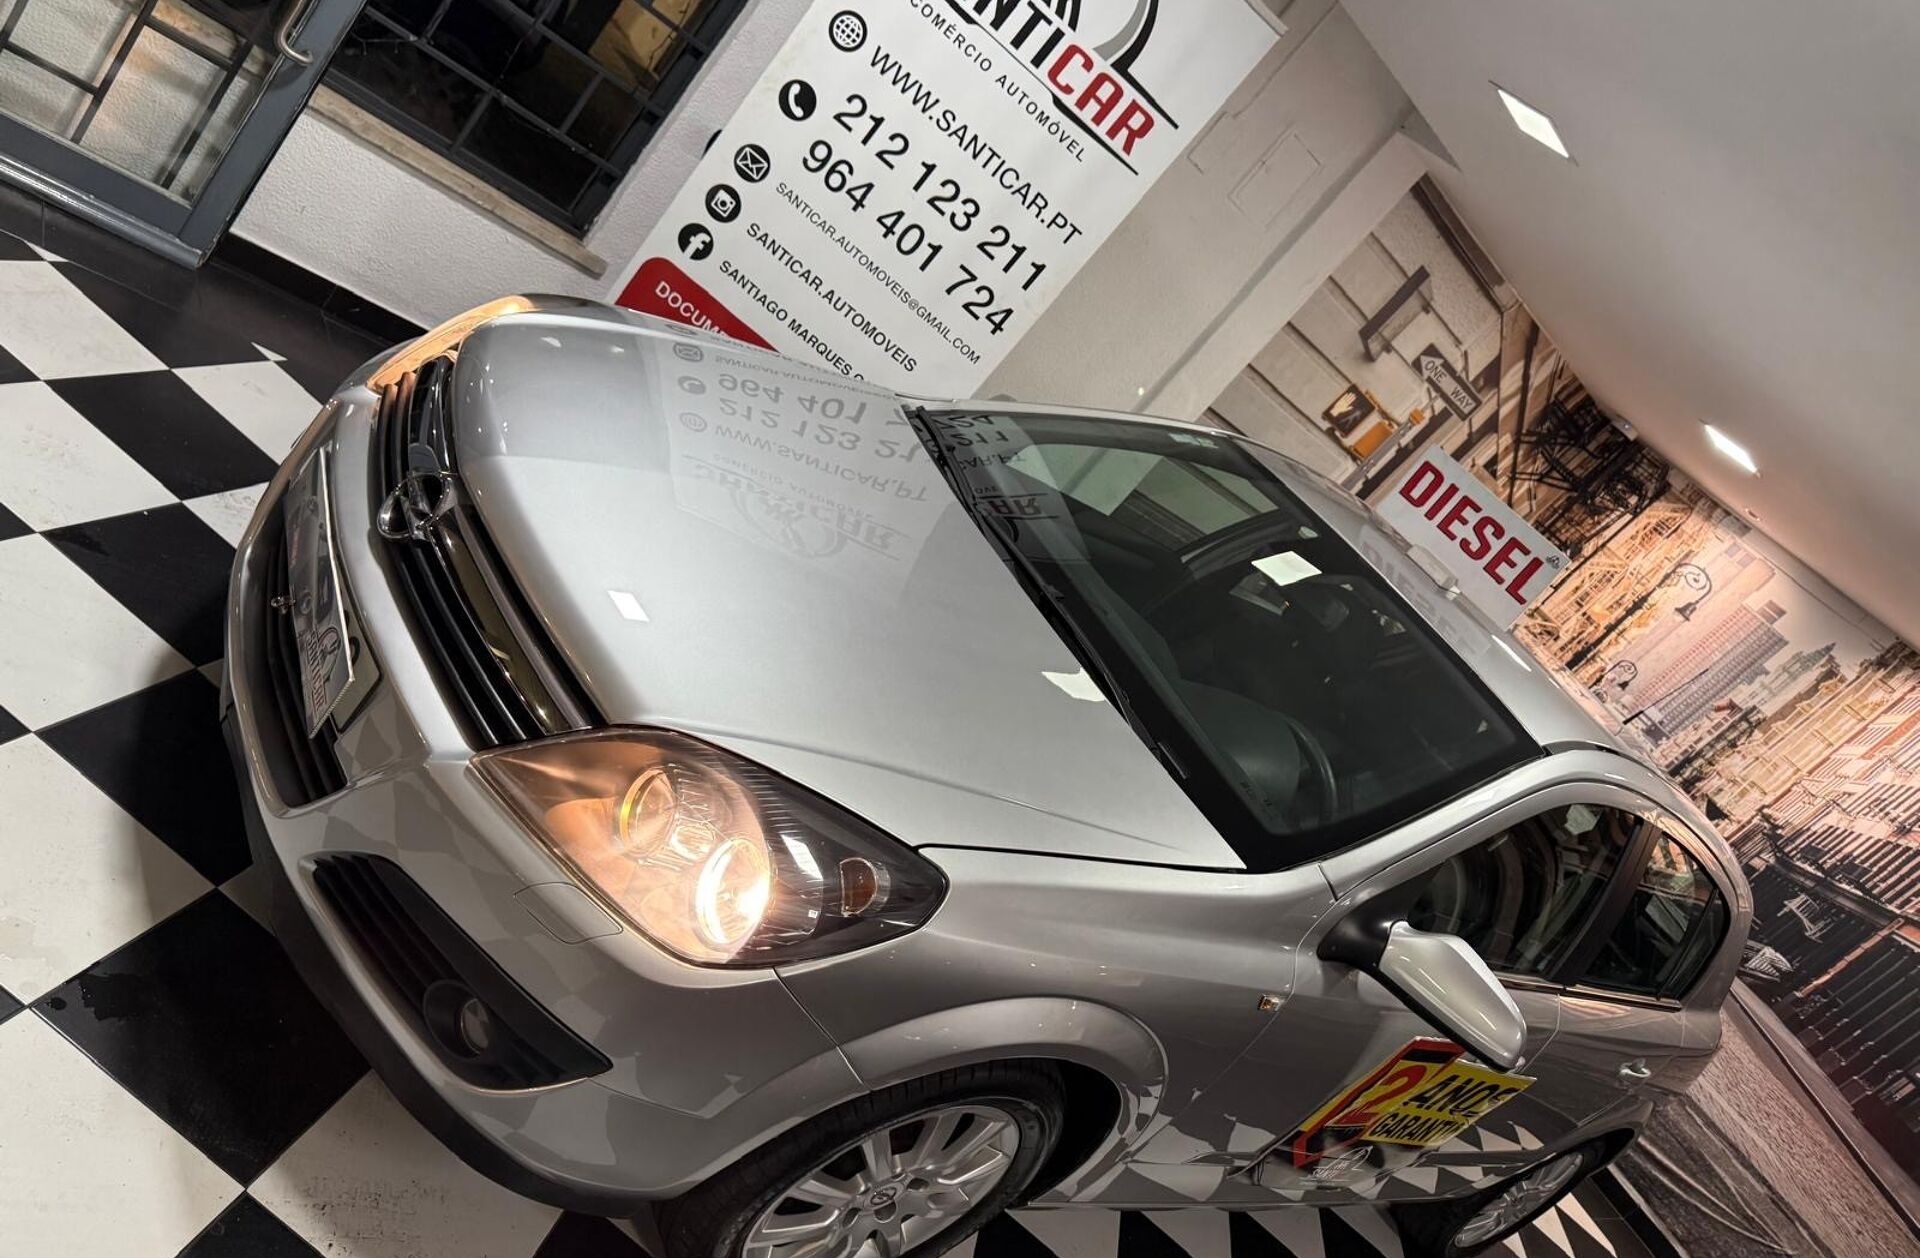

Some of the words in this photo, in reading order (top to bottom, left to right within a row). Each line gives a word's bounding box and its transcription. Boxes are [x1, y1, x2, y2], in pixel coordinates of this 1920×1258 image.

[871, 45, 1082, 245] WWW.SANTICAR.PT
[995, 75, 1085, 162] AUTOMÓVEL
[802, 139, 875, 213] 964
[876, 210, 943, 273] 401
[944, 263, 1014, 336] 724
[833, 93, 910, 170] 212
[913, 161, 981, 232] 123
[976, 224, 1047, 292] 211
[655, 281, 728, 337] DOCUM
[719, 260, 788, 322] SANTIAGO
[787, 318, 853, 376] MARQUES
[746, 222, 917, 372] SANTICAR.AUTOMOVEIS
[775, 182, 981, 366] SANTICAR.AUTOMOVEIS@GMAIL.COM
[1425, 360, 1447, 384] ONE
[1450, 386, 1473, 409] WAY
[1399, 461, 1544, 605] DIESEL
[1331, 1064, 1428, 1125] 2
